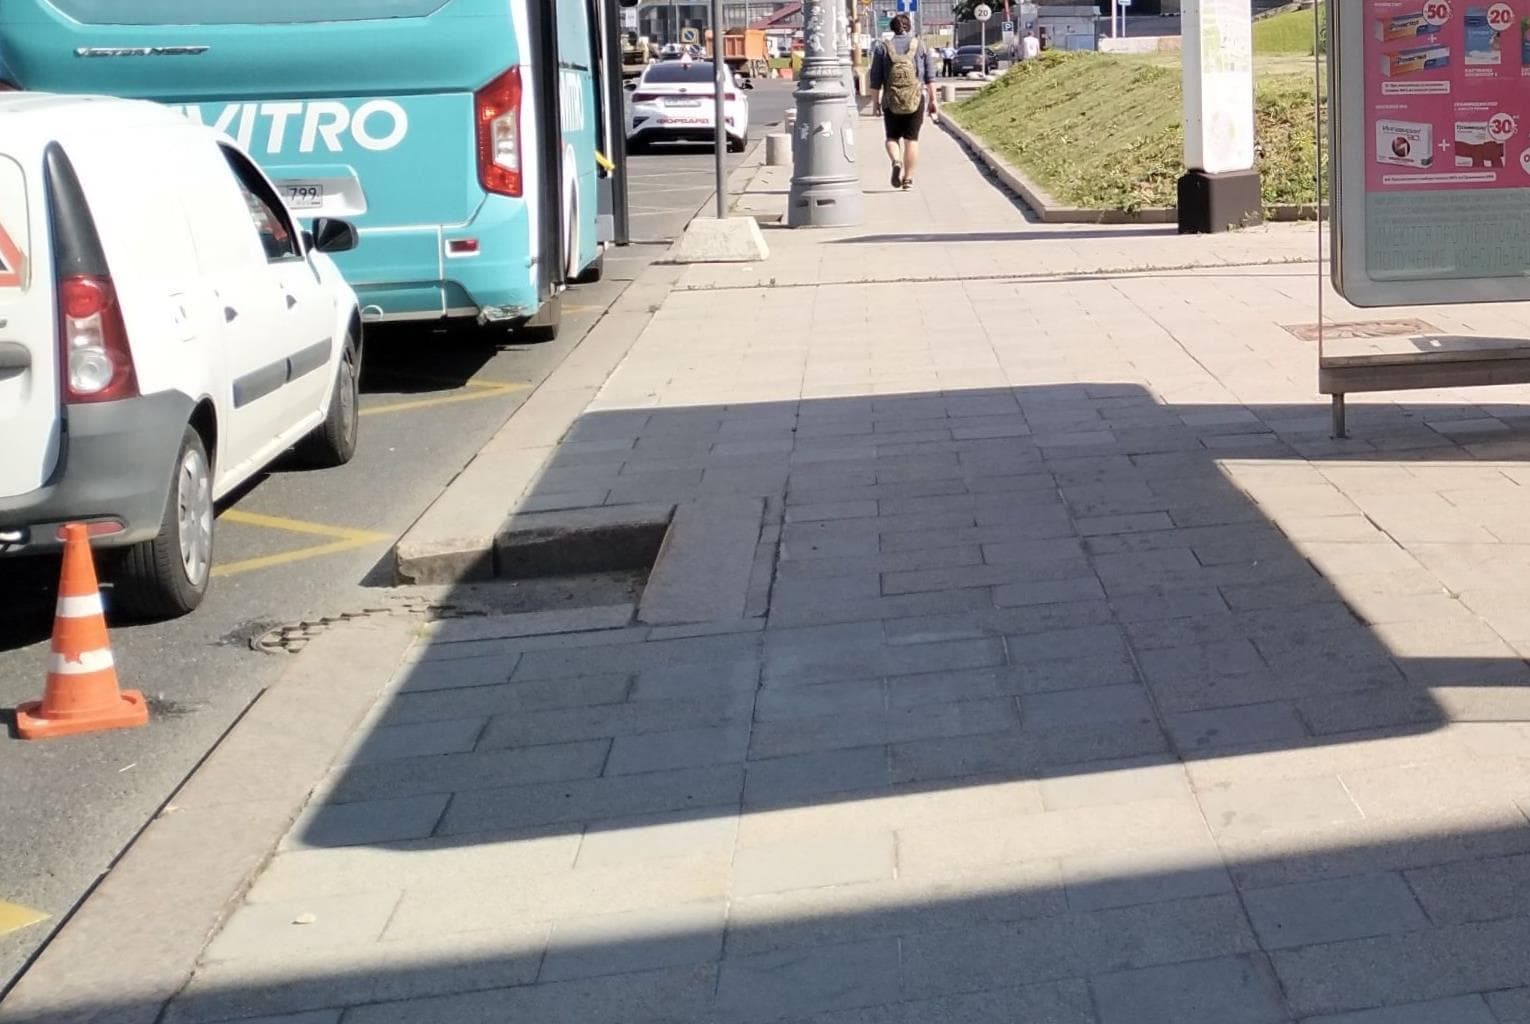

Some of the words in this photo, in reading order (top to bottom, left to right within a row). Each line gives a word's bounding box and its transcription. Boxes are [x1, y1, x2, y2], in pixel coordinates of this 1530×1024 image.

[978, 9, 989, 17] 20
[182, 99, 408, 154] VITRO
[288, 187, 317, 201] 799
